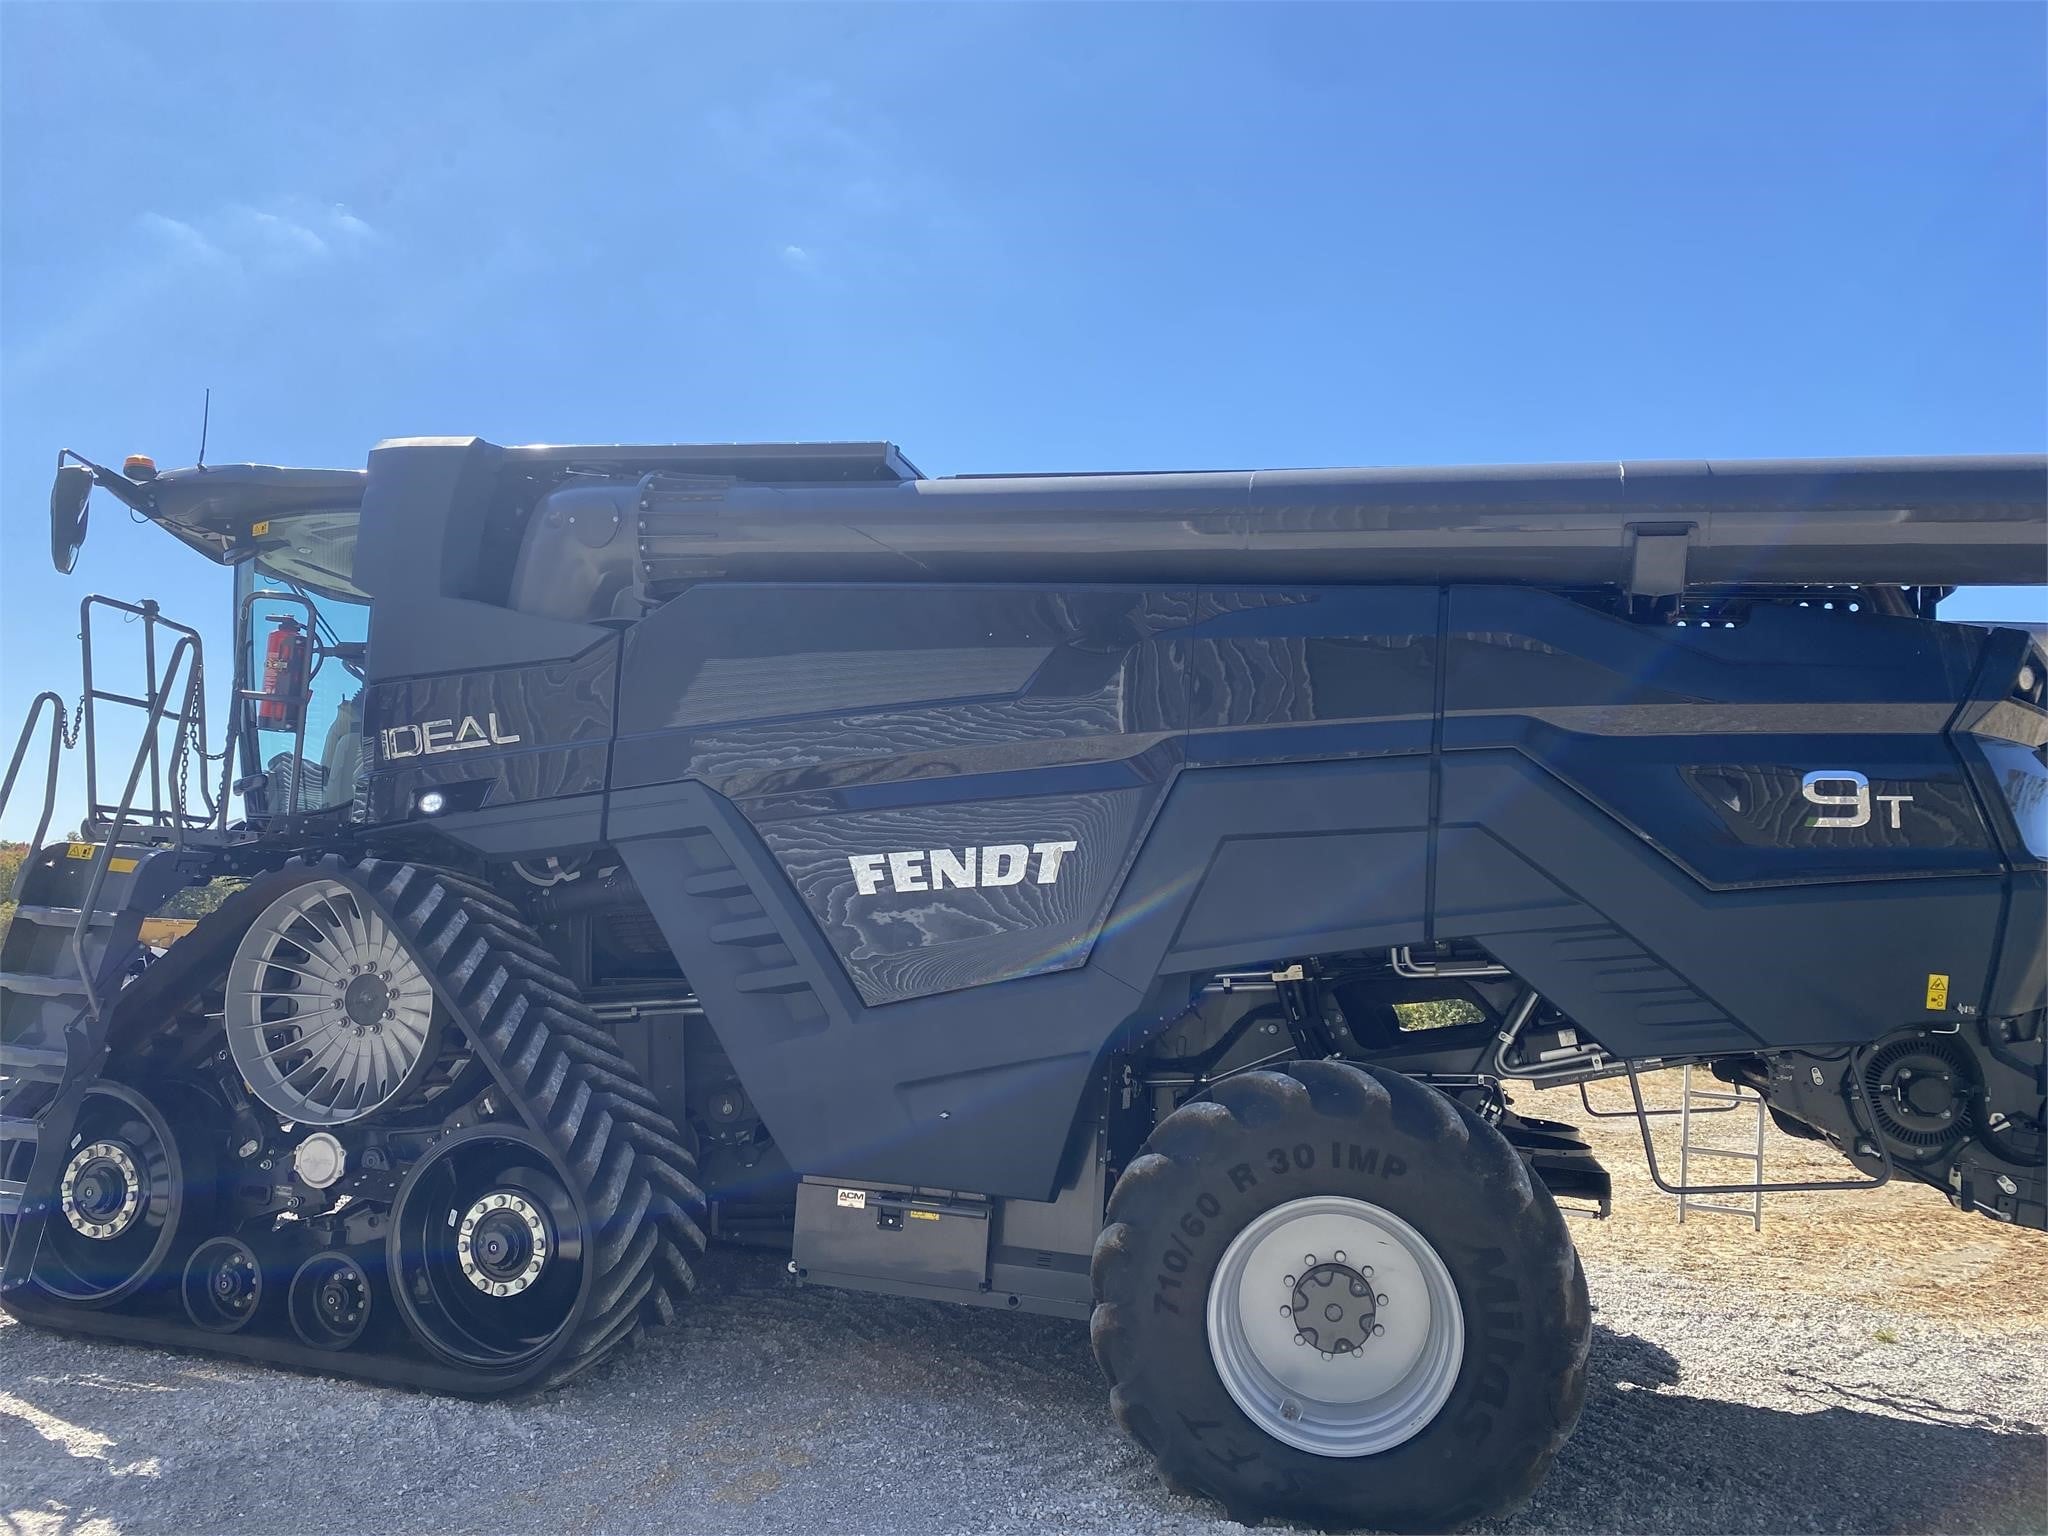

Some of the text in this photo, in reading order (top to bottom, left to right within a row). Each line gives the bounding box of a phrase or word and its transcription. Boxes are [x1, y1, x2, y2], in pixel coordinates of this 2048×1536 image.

[381, 713, 520, 760] IDEAL
[848, 841, 1078, 895] FENDT
[840, 1191, 864, 1200] ACM
[1153, 1142, 1408, 1315] 710/60 R 30 IMP
